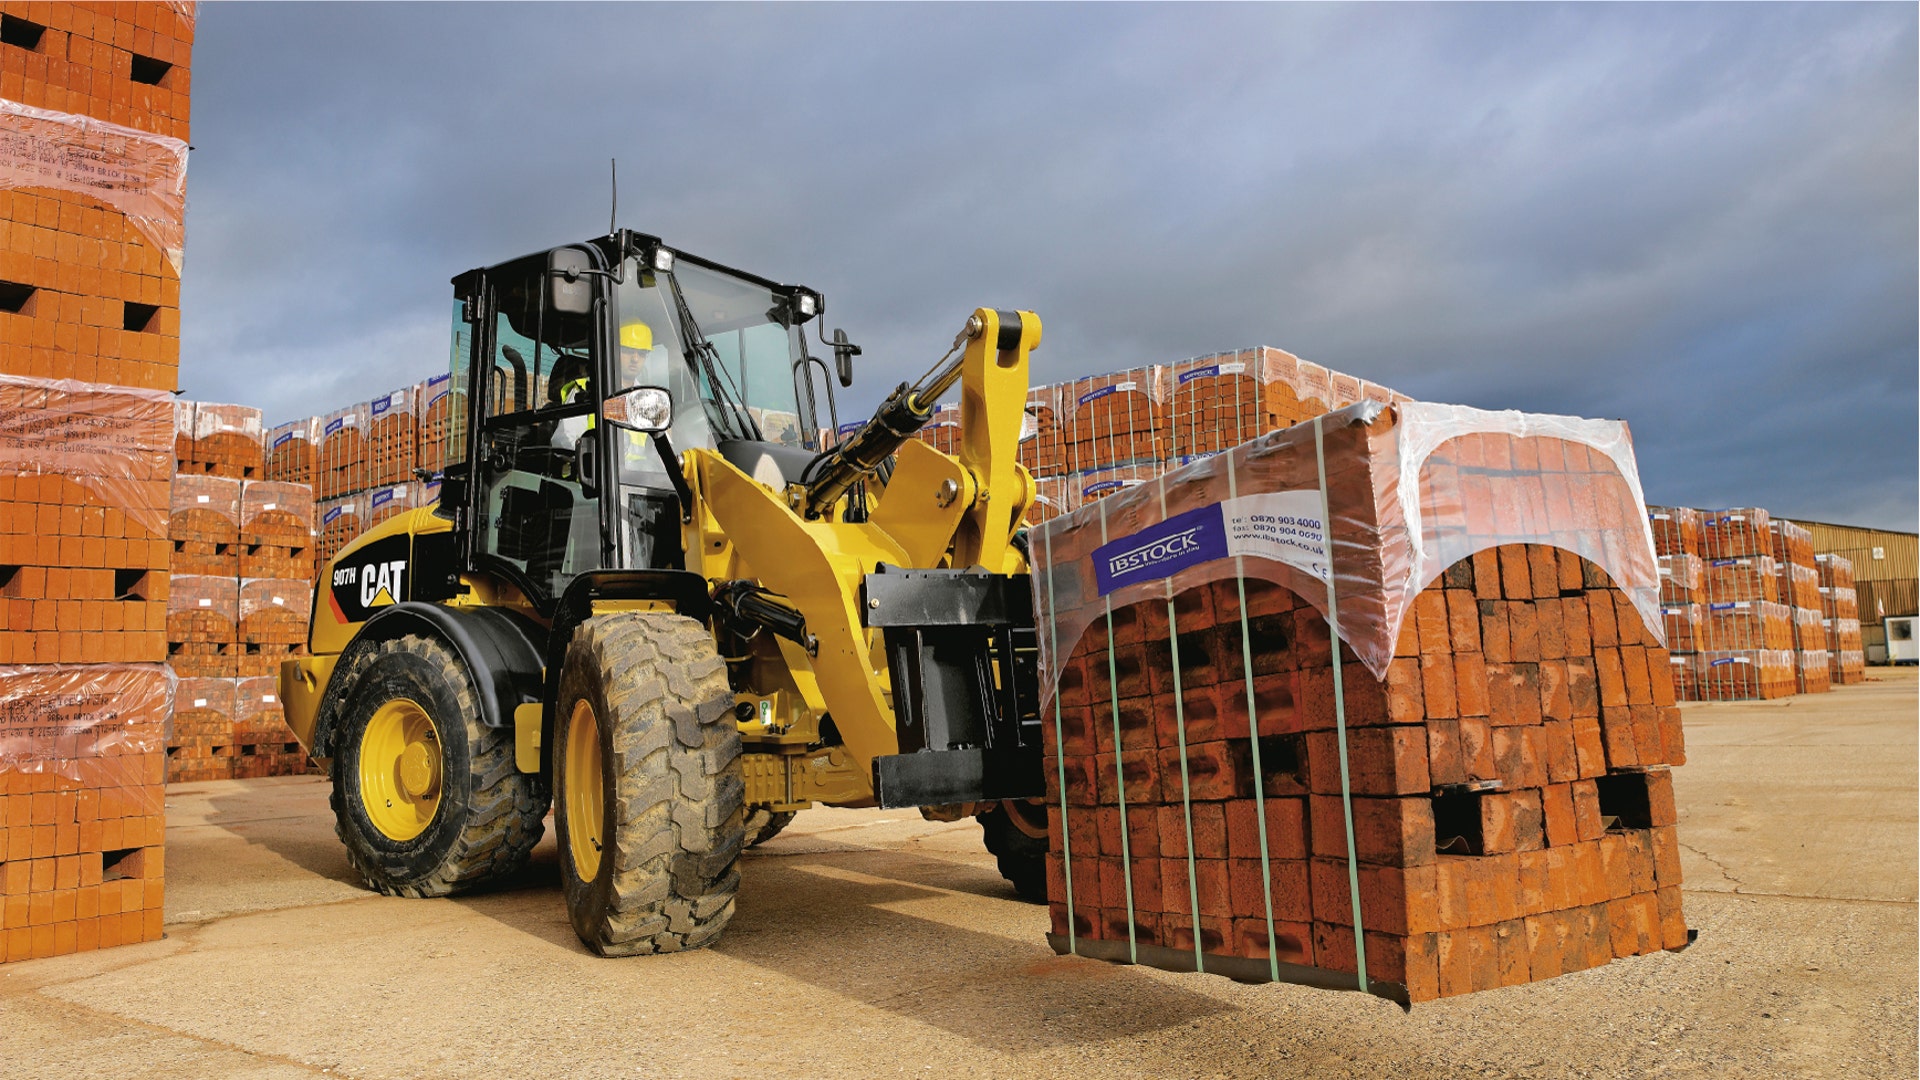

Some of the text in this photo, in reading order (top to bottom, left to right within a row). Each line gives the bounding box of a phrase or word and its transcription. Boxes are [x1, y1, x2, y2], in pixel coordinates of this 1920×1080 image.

[97, 167, 120, 178] BRICK
[1250, 515, 1275, 524] 0870
[1277, 516, 1295, 525] 903
[1296, 518, 1321, 530] 4000
[1253, 524, 1276, 534] 0870
[1279, 526, 1297, 535] 904
[1109, 532, 1199, 574] IBSTOCK
[1234, 533, 1324, 556] www.ibstock.co.uk
[333, 560, 406, 608] 907H CAT
